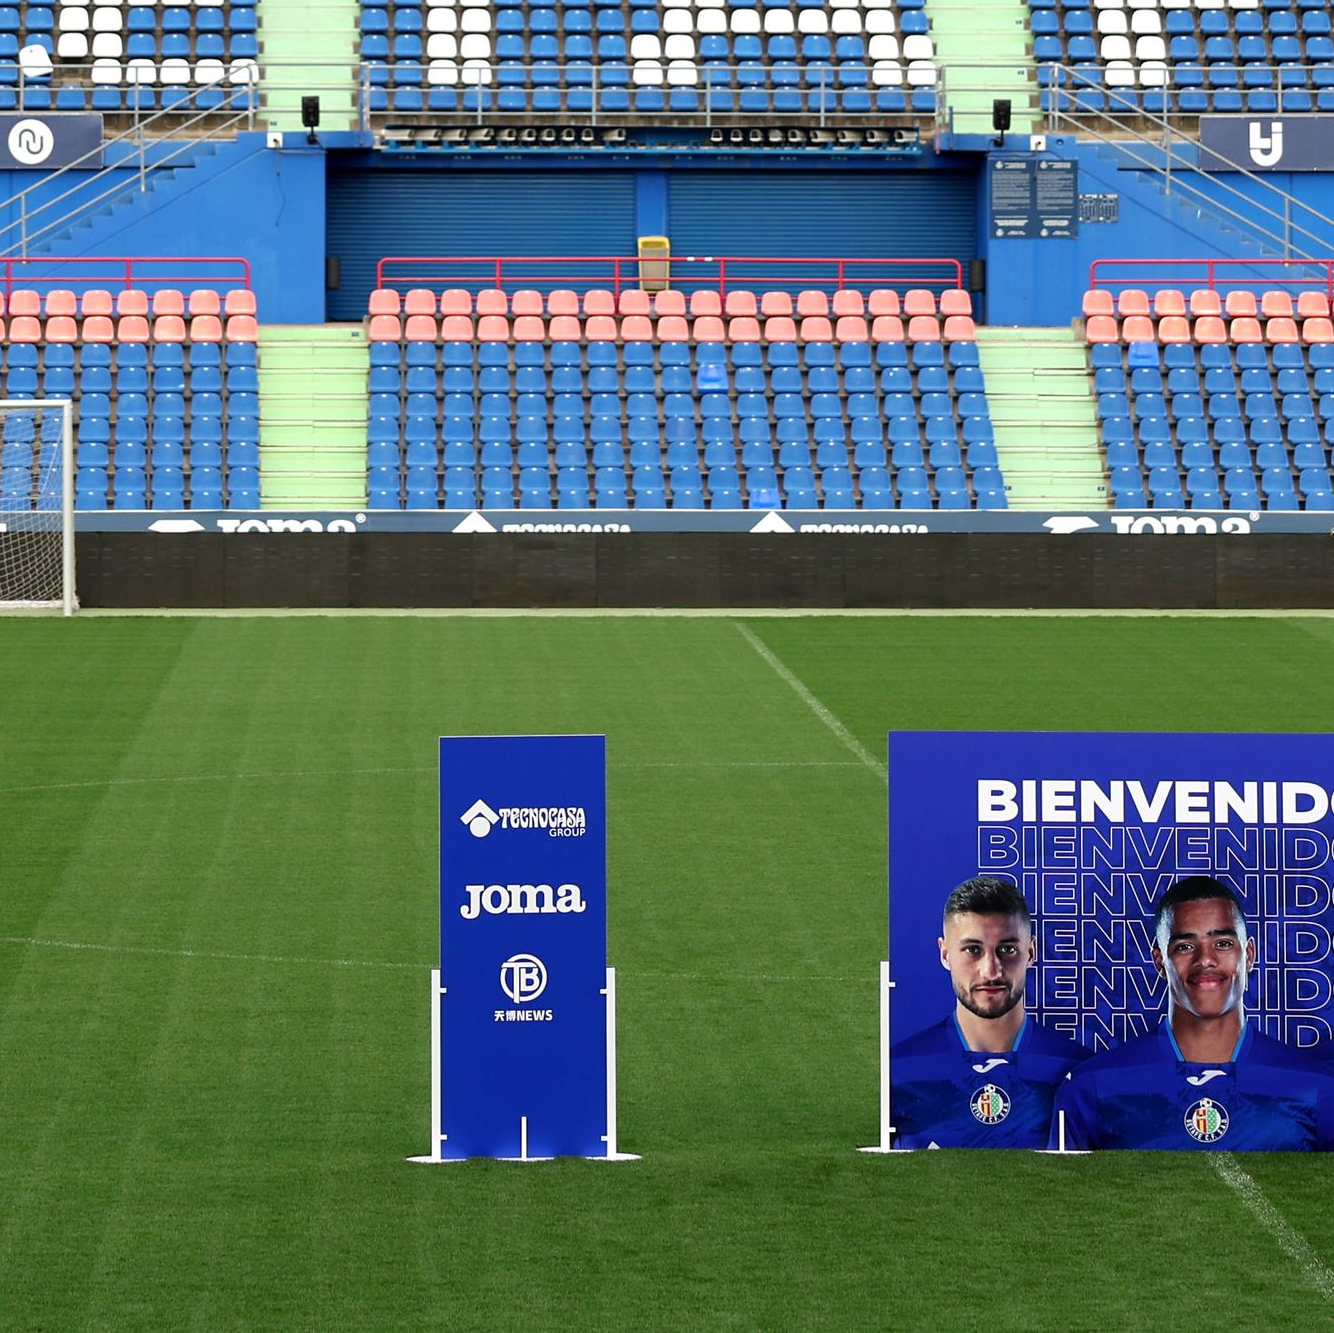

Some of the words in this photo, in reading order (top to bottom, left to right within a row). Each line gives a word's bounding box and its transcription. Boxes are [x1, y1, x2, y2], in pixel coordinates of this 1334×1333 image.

[499, 807, 586, 828] TECNOCASA
[548, 826, 587, 838] GROUP
[460, 883, 587, 920] Joma
